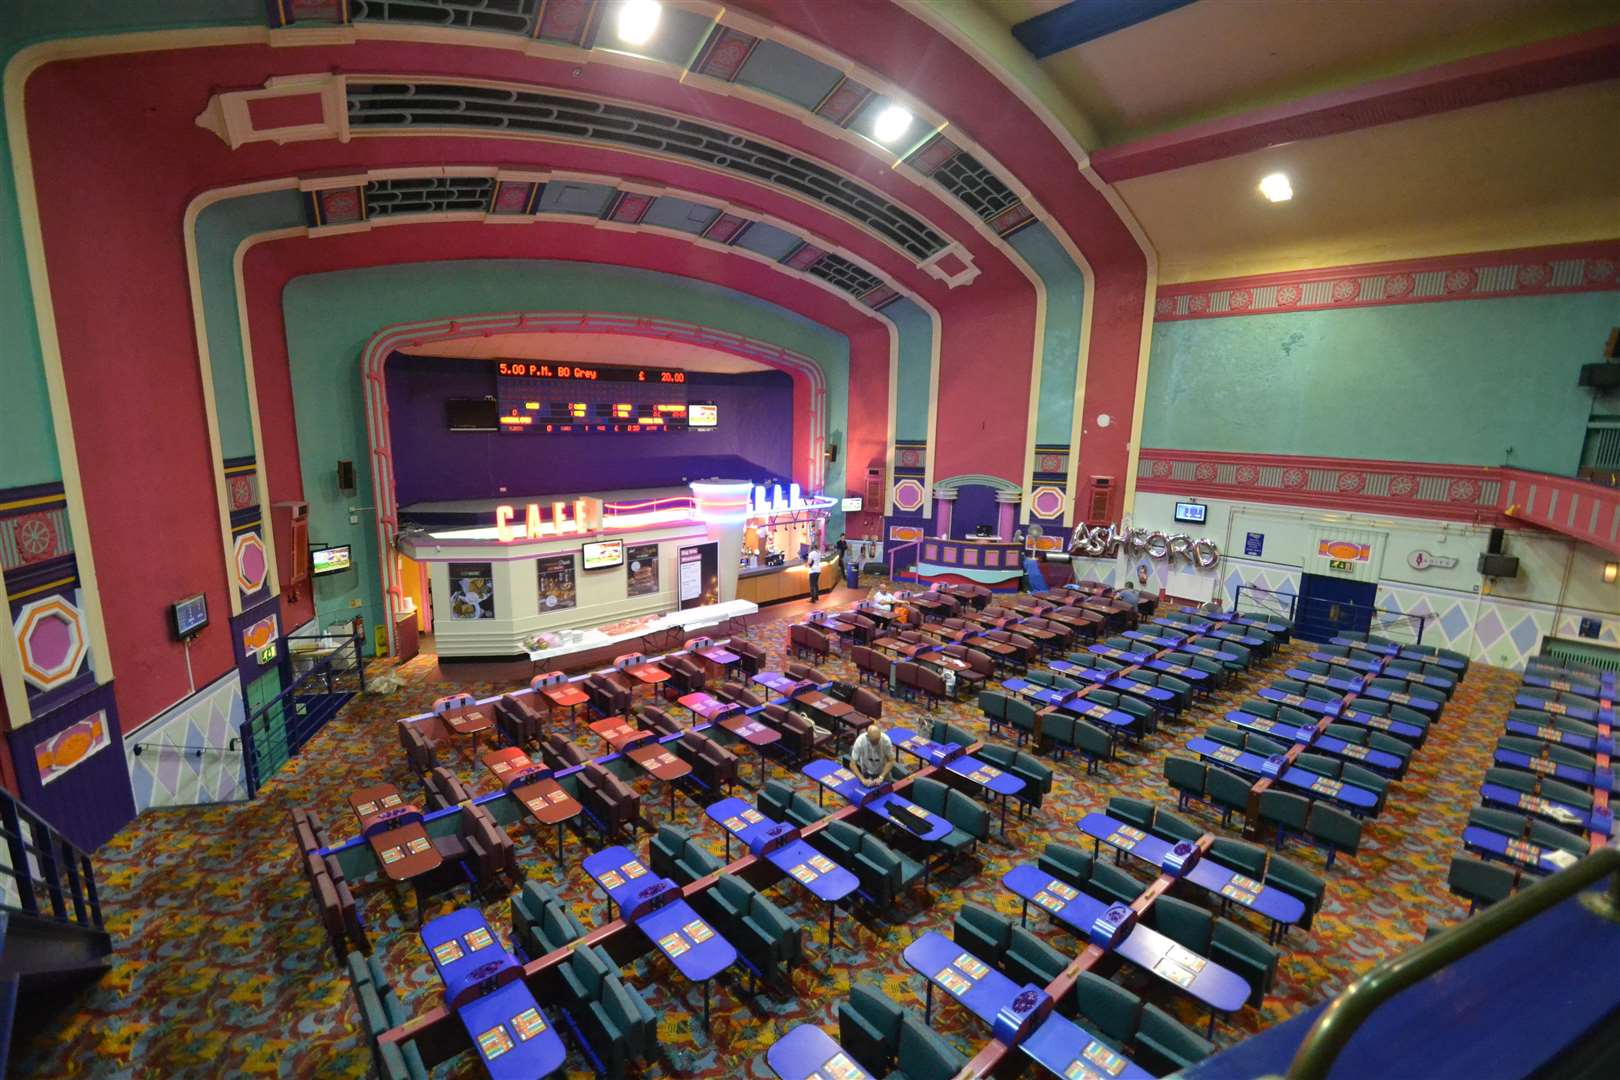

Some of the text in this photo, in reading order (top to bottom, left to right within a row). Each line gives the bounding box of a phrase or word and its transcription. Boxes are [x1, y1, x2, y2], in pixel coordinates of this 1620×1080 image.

[499, 363, 525, 375] 5.00
[529, 365, 553, 377] P.M.
[574, 367, 597, 380] Grey
[660, 372, 684, 383] 20.00
[496, 499, 590, 542] CAFE
[1068, 521, 1219, 569] ASHFORD
